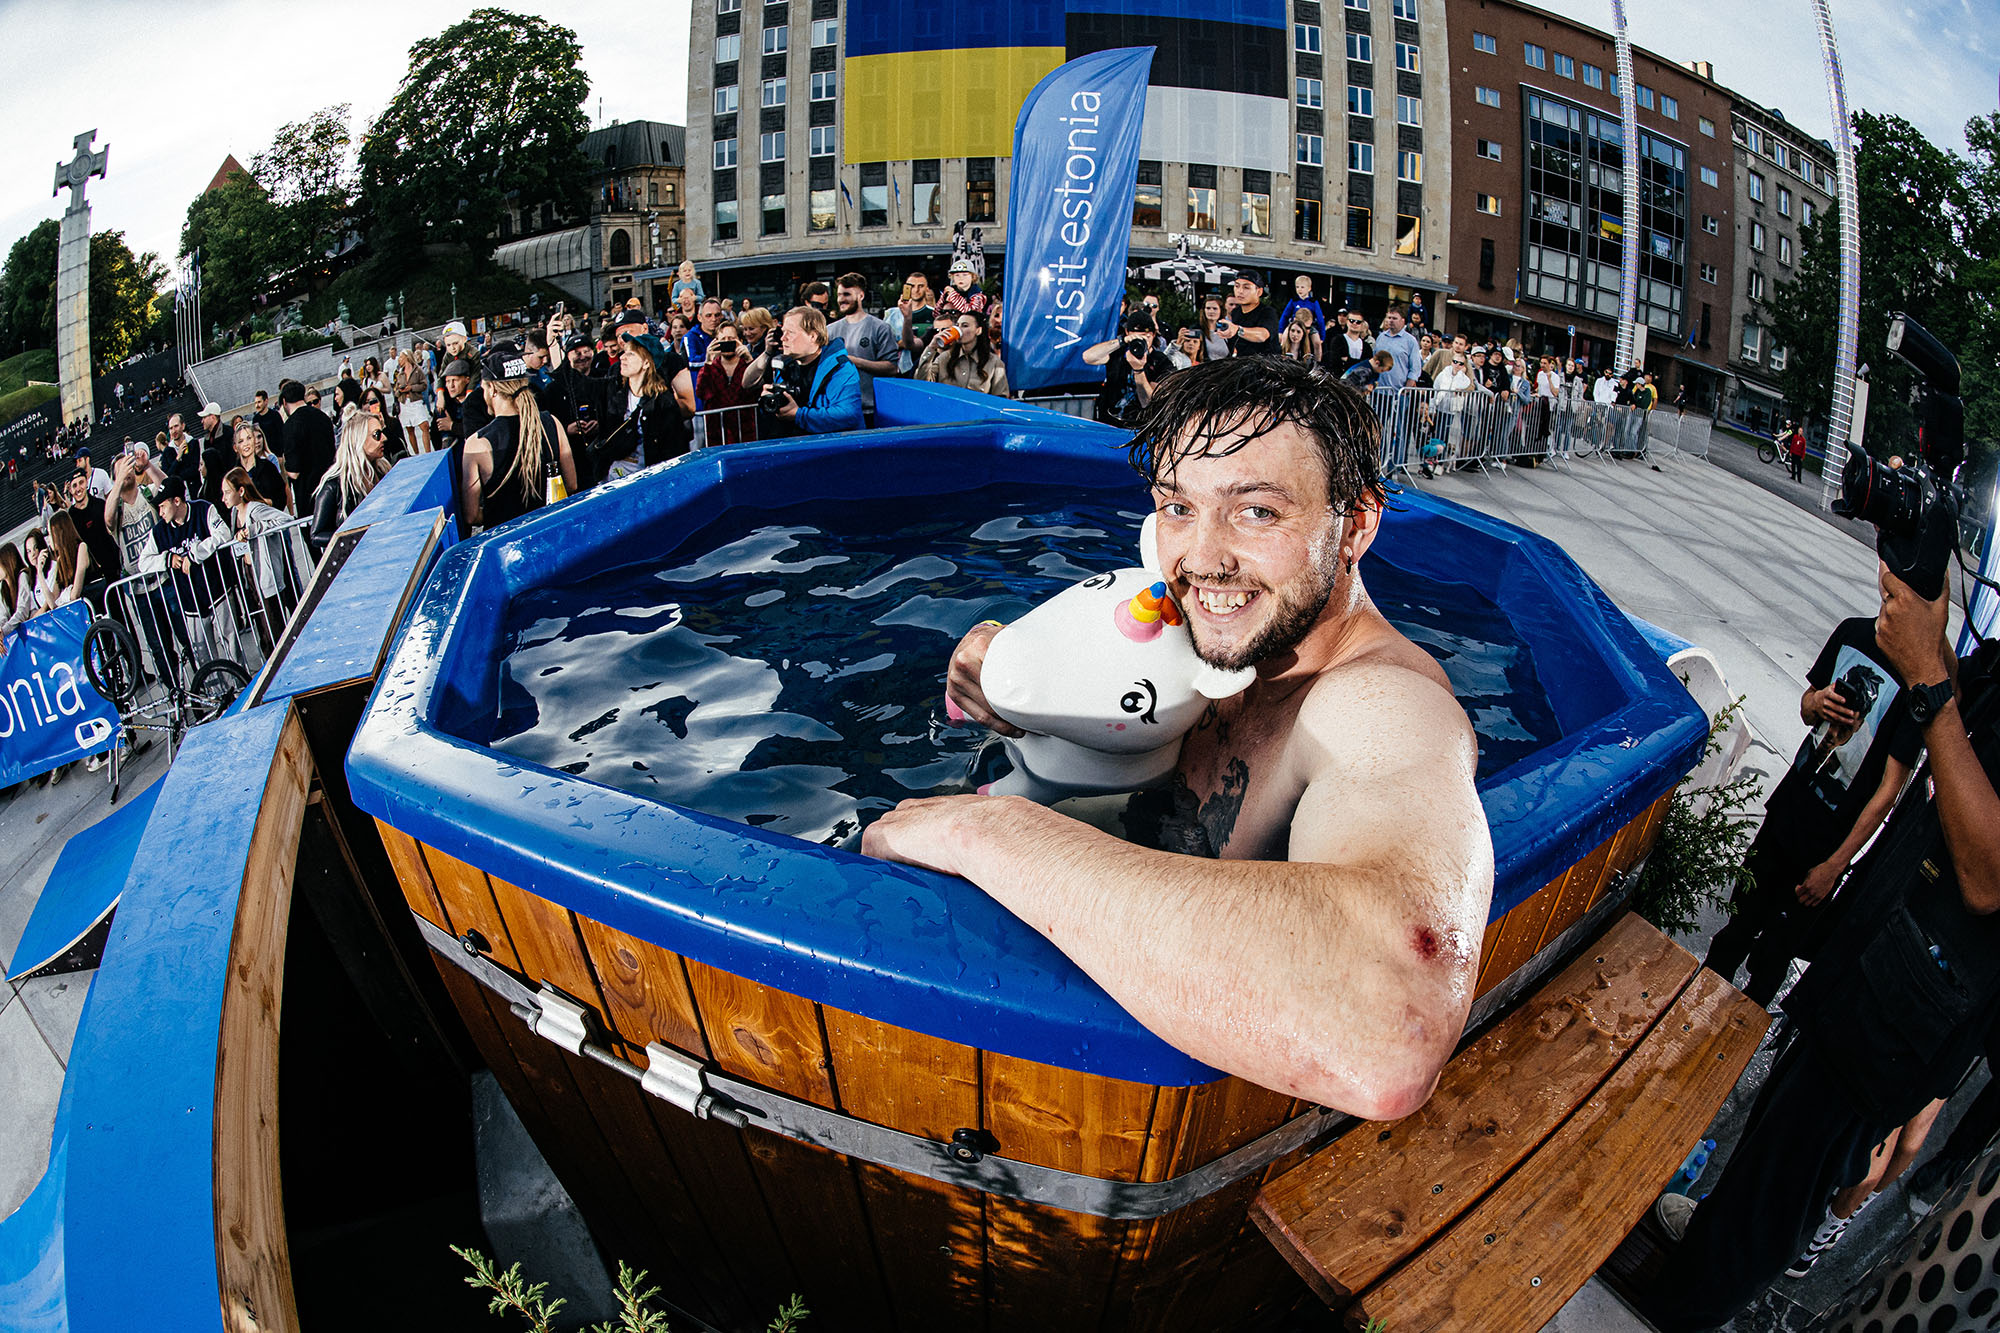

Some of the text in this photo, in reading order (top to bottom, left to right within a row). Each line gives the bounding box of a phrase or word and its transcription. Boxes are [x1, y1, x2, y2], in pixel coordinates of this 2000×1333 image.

[1045, 91, 1101, 349] visit estonia
[1210, 236, 1245, 249] Joe's
[126, 516, 151, 541] BLND
